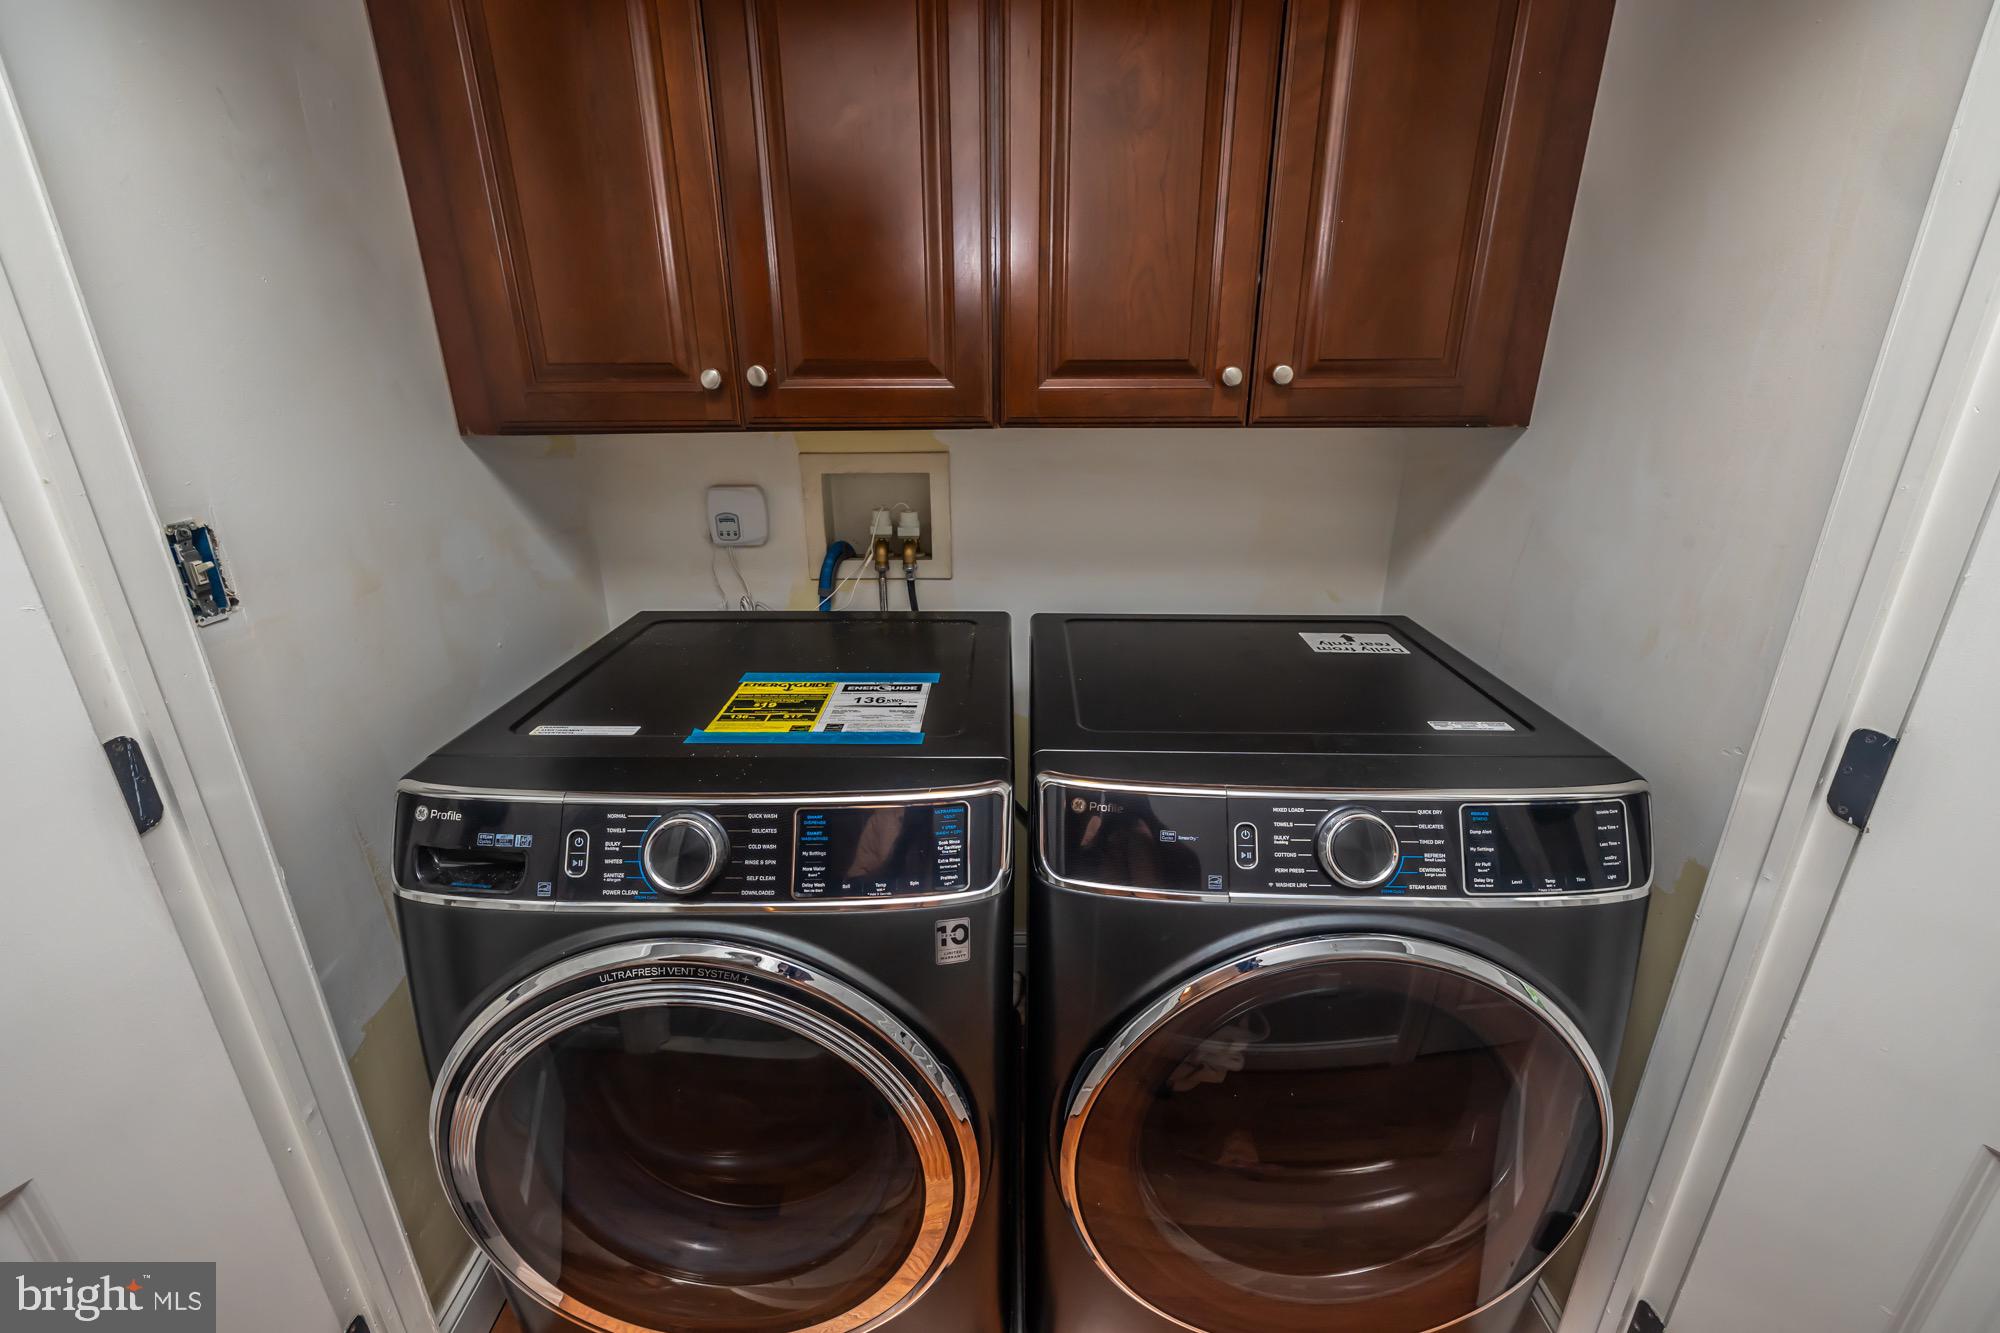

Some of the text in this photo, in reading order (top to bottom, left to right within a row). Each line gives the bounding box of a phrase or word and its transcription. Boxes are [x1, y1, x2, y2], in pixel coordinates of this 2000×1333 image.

[742, 682, 835, 692] ENERGYGUIDE
[853, 696, 888, 704] 136
[1089, 801, 1124, 813] Profile
[430, 809, 462, 821] Profile
[936, 923, 969, 947] 10
[599, 966, 666, 984] ULTRAFRESH
[666, 966, 696, 977] VENT
[697, 967, 740, 982] SYSTEM
